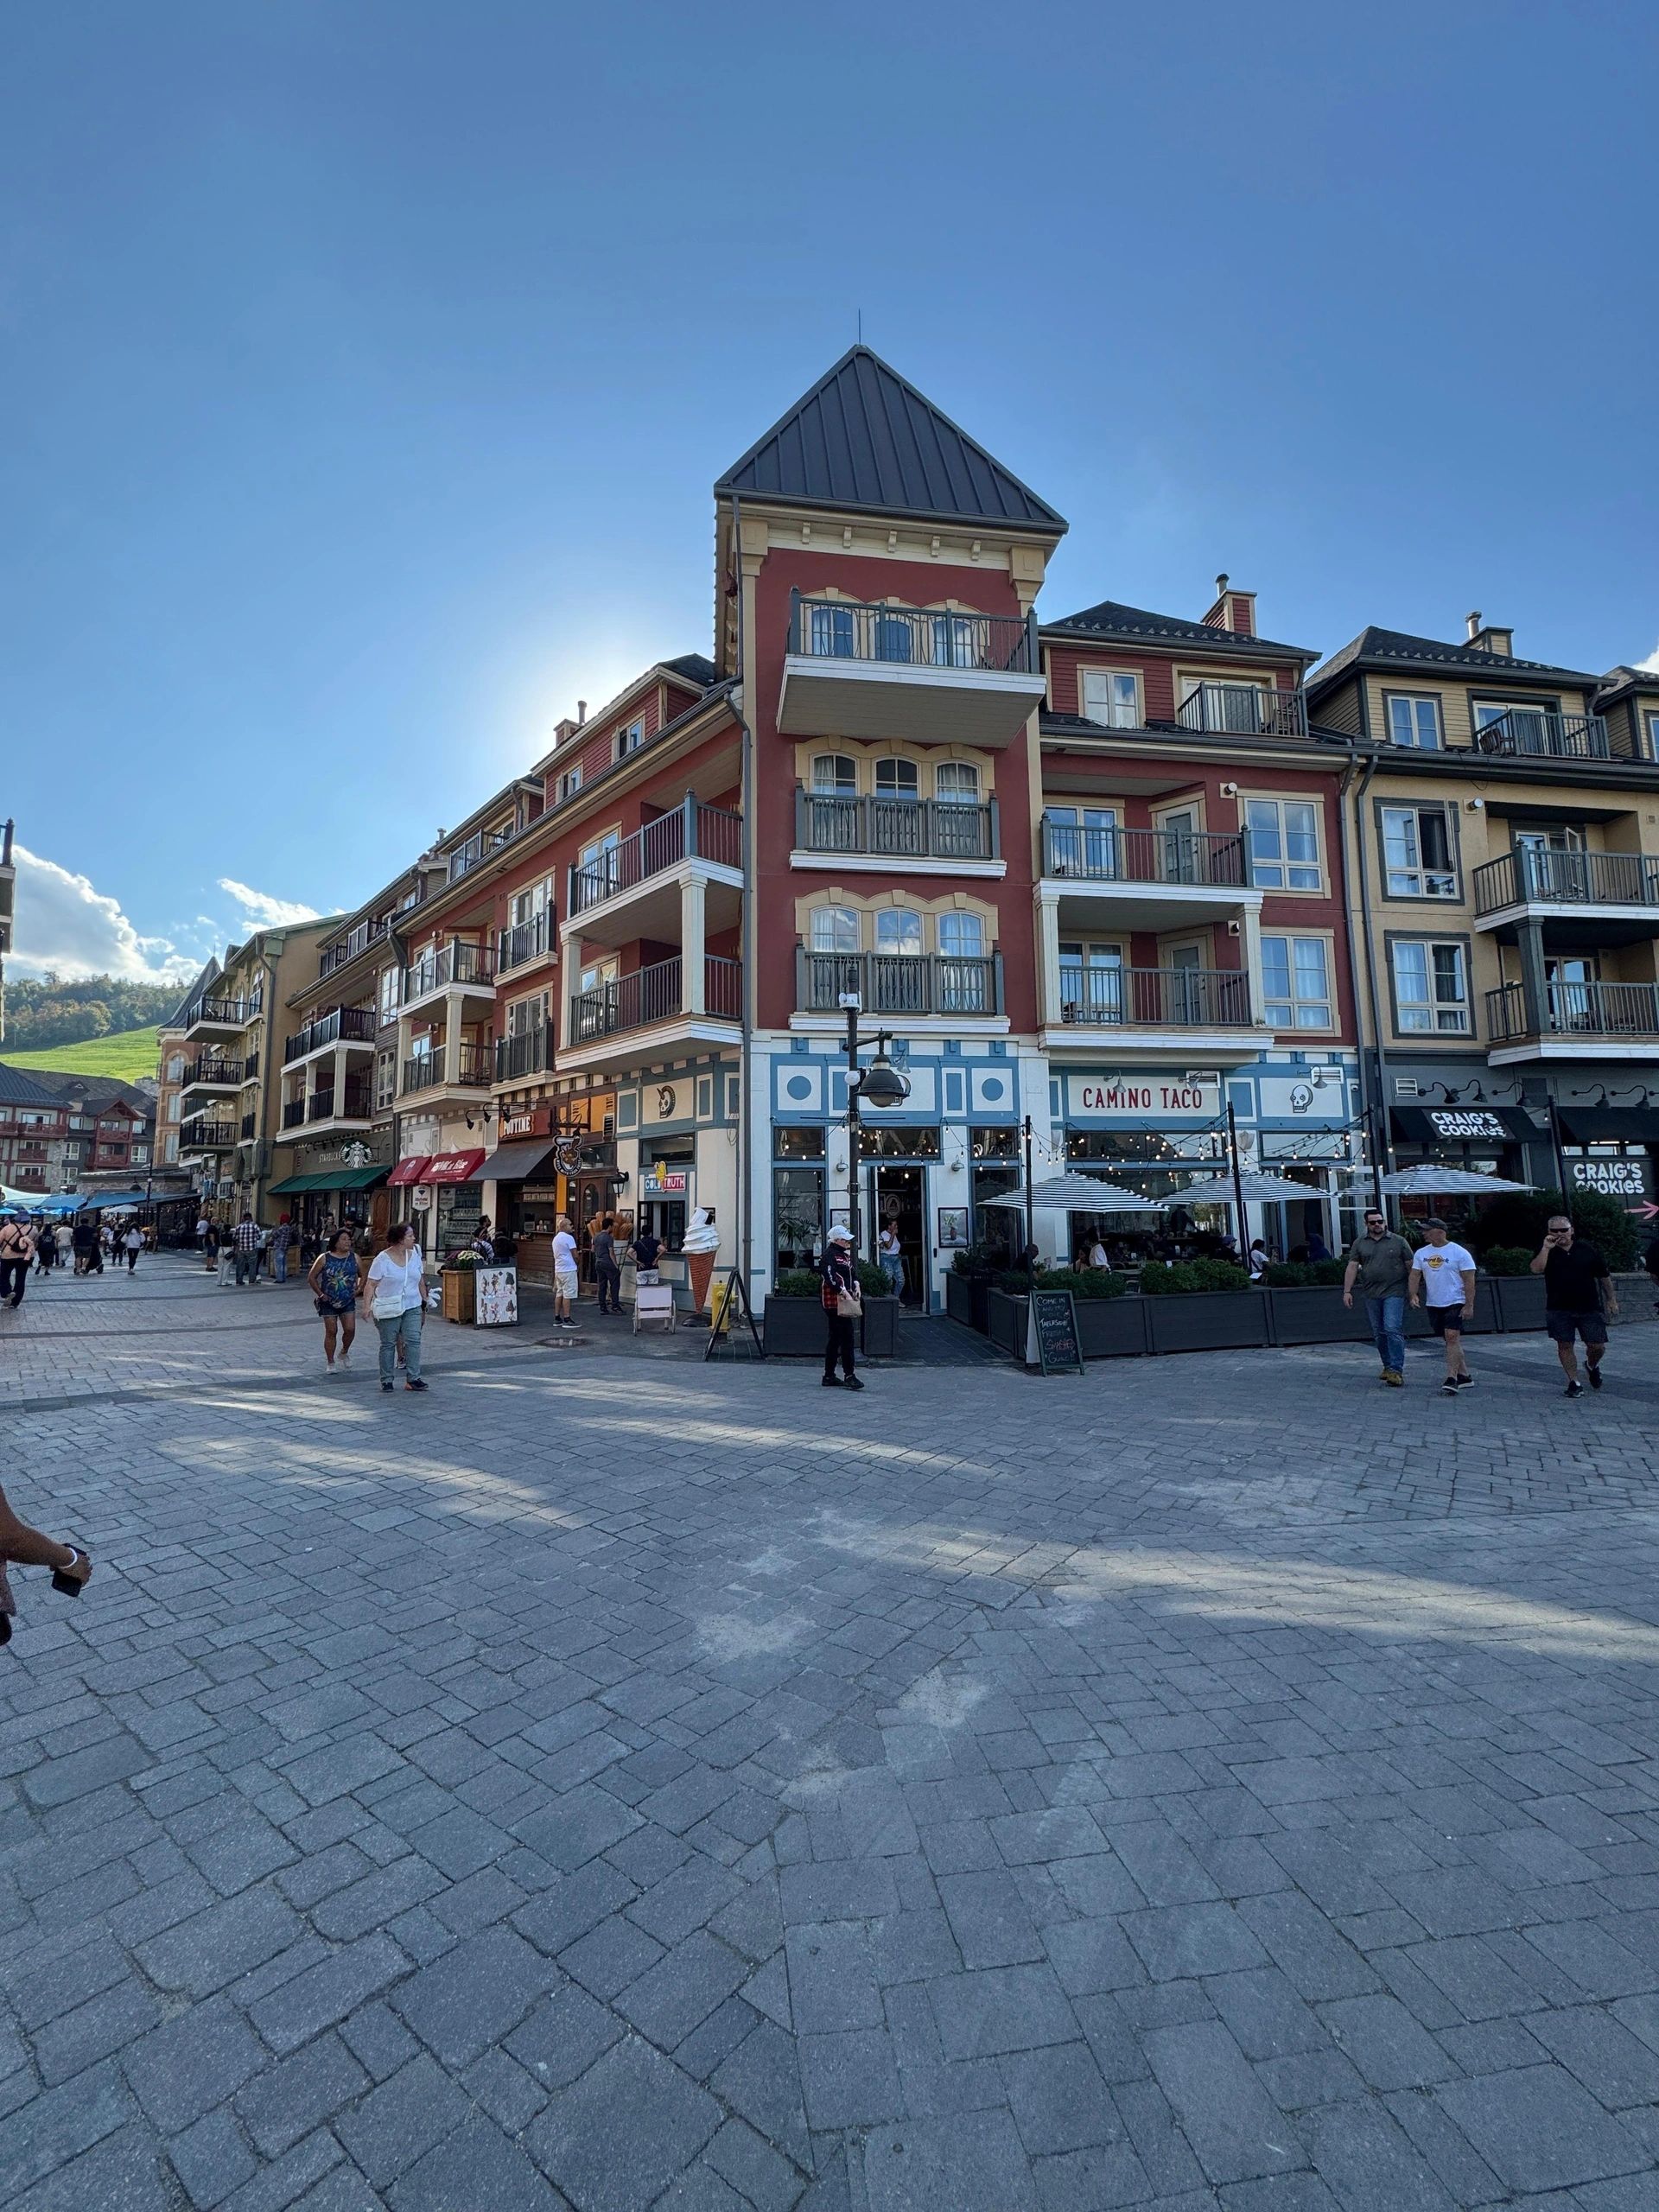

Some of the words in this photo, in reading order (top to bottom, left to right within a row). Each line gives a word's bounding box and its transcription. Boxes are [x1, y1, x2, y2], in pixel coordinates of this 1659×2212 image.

[1084, 1088, 1152, 1109] CAMINO
[1160, 1088, 1203, 1109] TACO
[1431, 1112, 1499, 1125] CRAIG'S
[1573, 1163, 1643, 1179] CRAIG'S
[664, 1177, 684, 1188] TRUTH
[1037, 1296, 1057, 1306] COME
